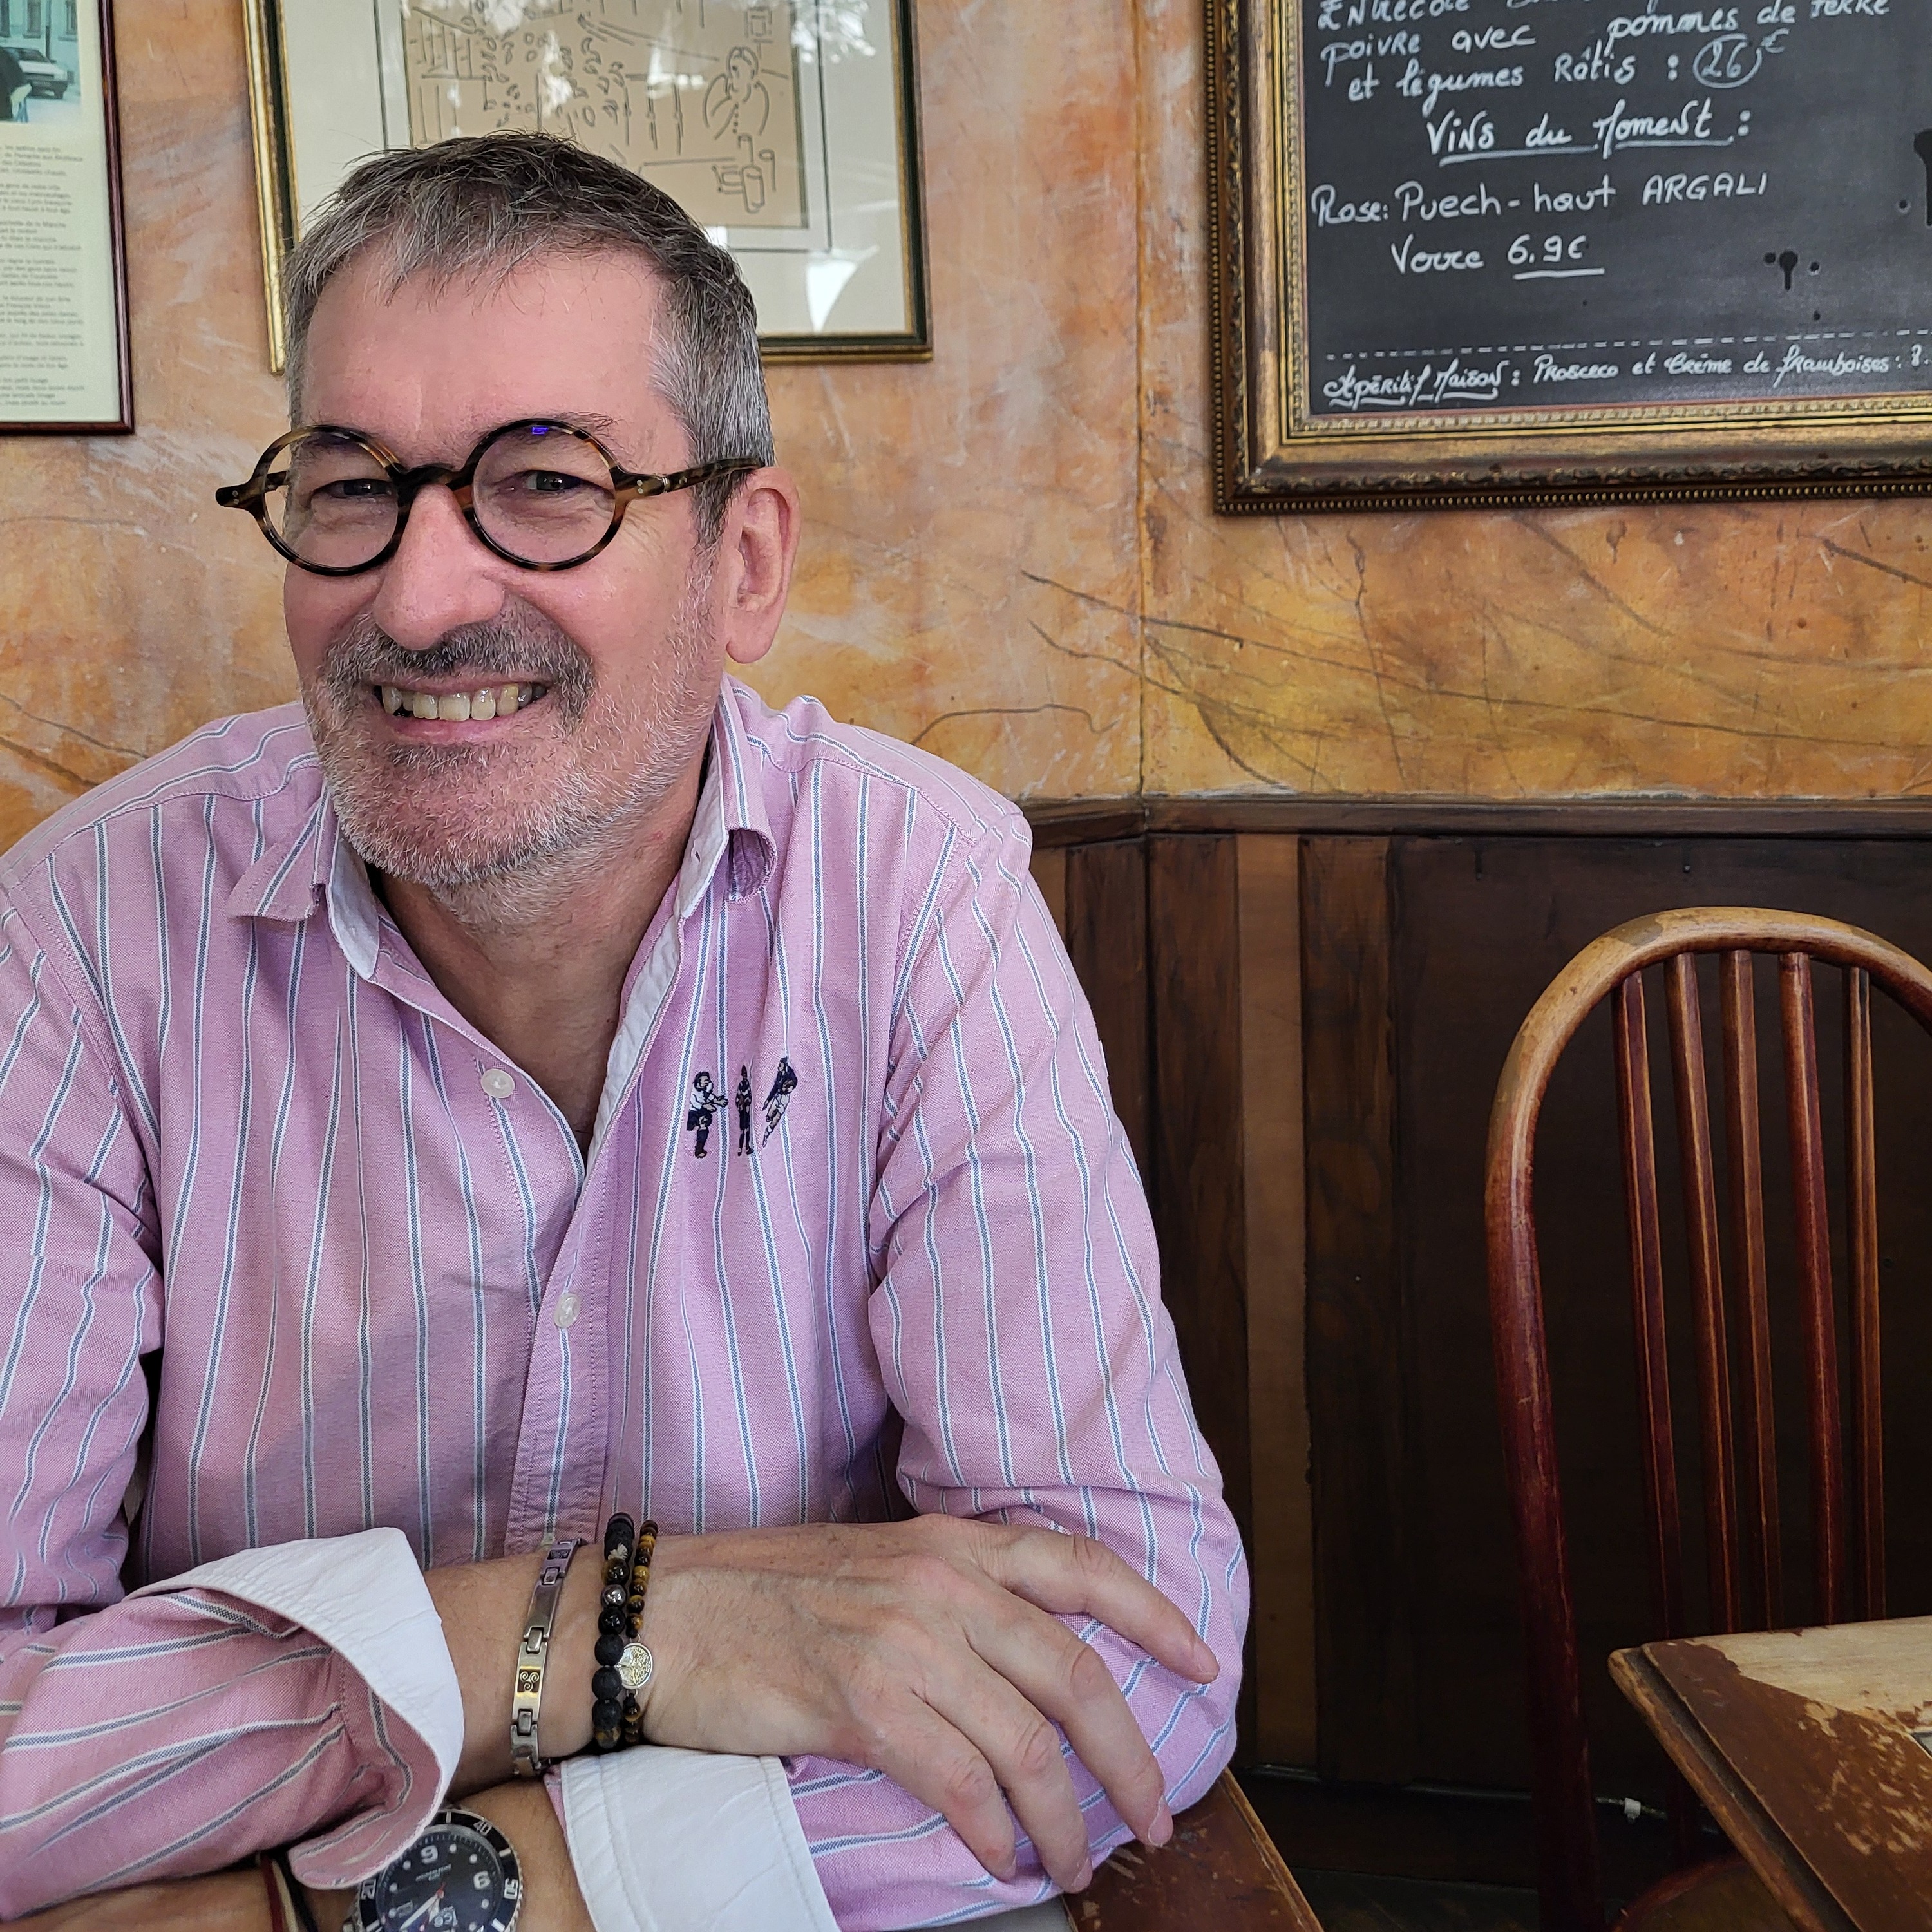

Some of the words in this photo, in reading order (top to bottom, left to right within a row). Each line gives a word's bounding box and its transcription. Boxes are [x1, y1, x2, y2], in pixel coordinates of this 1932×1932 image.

[1451, 25, 1537, 53] avec
[1605, 6, 1739, 57] pommes
[1757, 0, 1796, 24] de
[1348, 62, 1380, 102] et
[1526, 113, 1572, 147] du
[1642, 172, 1768, 205] ARGALI
[1632, 352, 1656, 375] et
[1743, 350, 1770, 374] de
